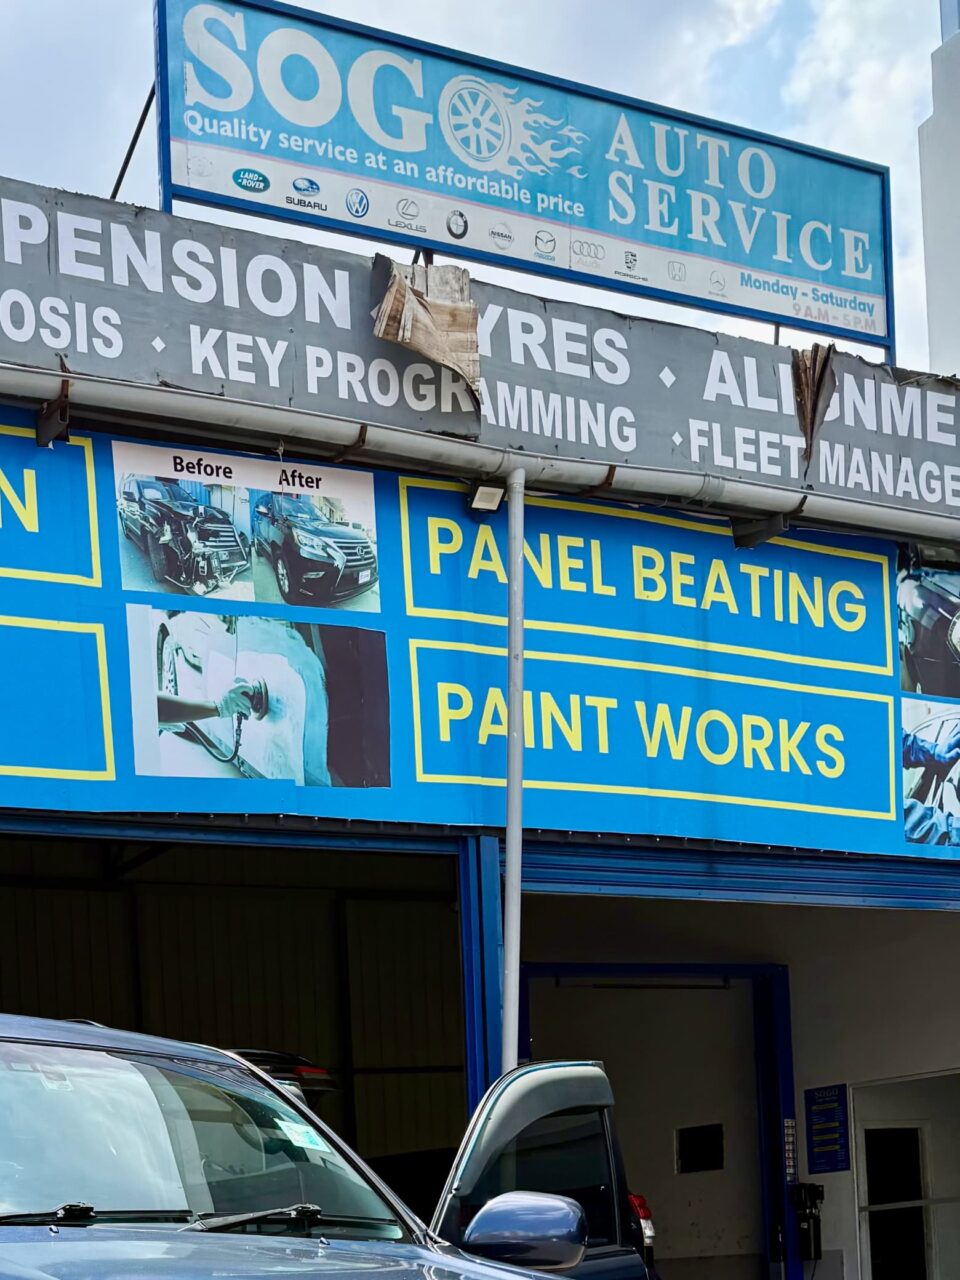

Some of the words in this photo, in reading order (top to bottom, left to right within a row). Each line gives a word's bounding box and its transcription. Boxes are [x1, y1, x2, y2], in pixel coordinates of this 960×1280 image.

[184, 110, 271, 149] Quality
[278, 133, 358, 164] service
[365, 150, 387, 171] at
[394, 161, 419, 179] an
[426, 165, 531, 204] affordable
[537, 192, 585, 217] price
[240, 171, 258, 181] LAND
[605, 112, 776, 199] AUTO
[242, 179, 264, 190] ROVER
[285, 196, 327, 211] SUBARU
[388, 218, 427, 233] LEXUS
[491, 230, 512, 240] NISSAN
[608, 171, 873, 280] SERVICE
[740, 272, 798, 300] Monday
[812, 287, 875, 317] Saturday
[477, 304, 631, 384] YRES
[190, 325, 289, 387] KEY
[306, 346, 637, 452] PROGRAMMING
[689, 419, 806, 478] FLEET
[172, 455, 233, 480] Before
[279, 468, 322, 490] After
[428, 517, 616, 596] PANEL
[632, 545, 867, 633] BEATING
[437, 682, 617, 754] PAINT
[635, 700, 846, 779] WORKS
